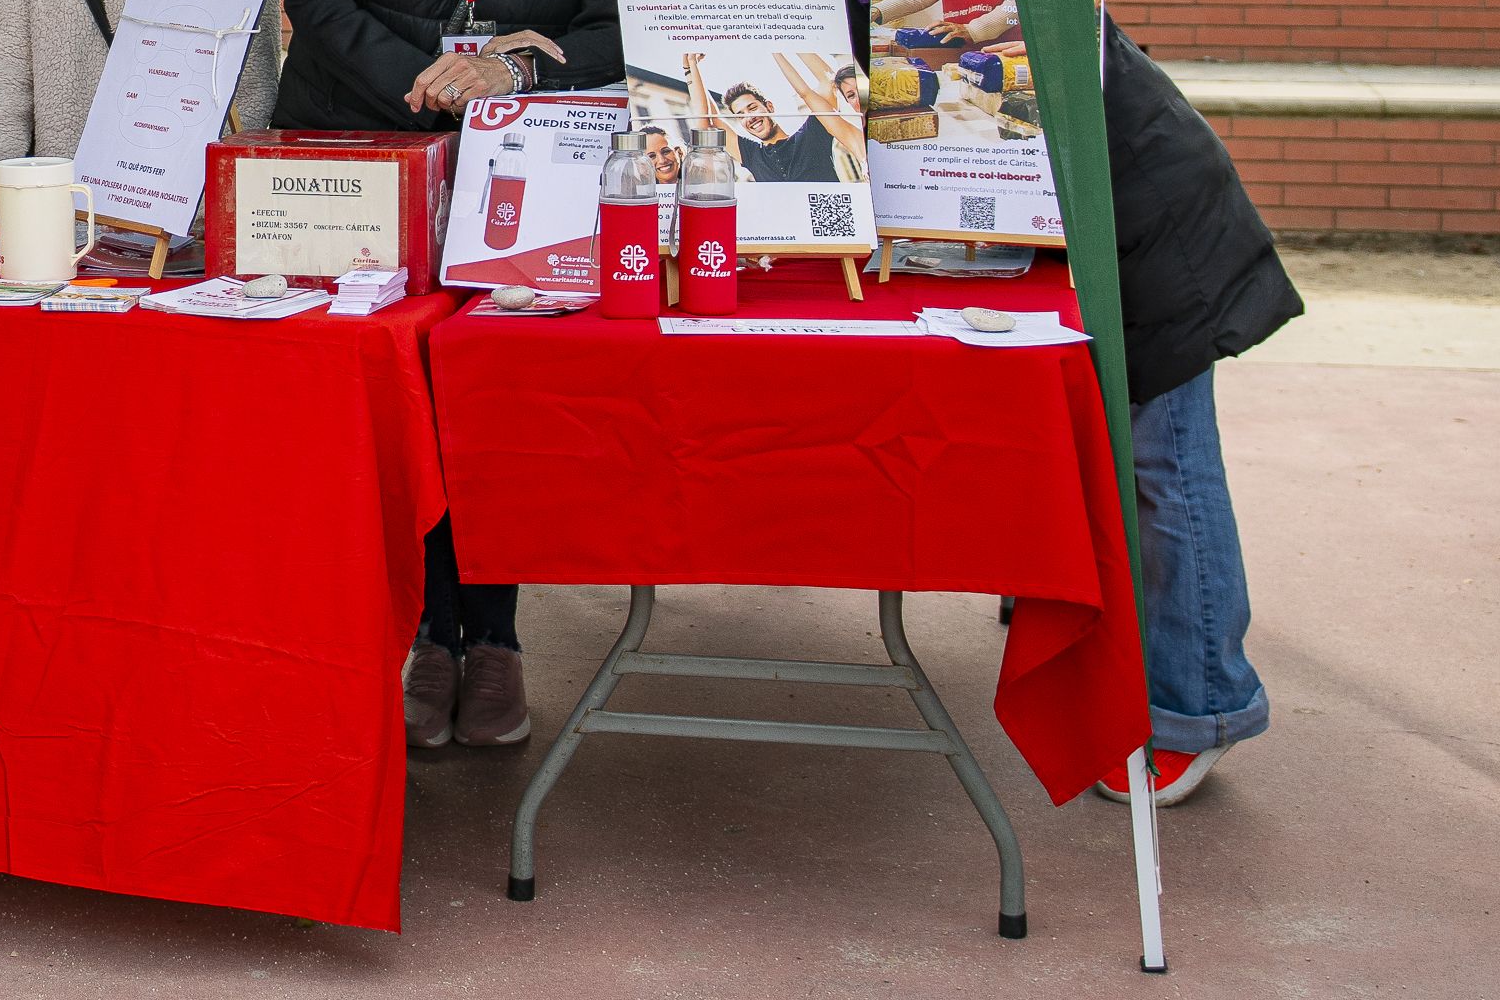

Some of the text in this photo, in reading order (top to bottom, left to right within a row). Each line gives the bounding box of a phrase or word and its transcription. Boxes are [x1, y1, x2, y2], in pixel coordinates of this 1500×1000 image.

[741, 3, 766, 11] procés
[805, 3, 835, 11] dinàmic
[567, 110, 617, 121] NO TE'N
[524, 119, 616, 132] QUEDIS SENSE!
[886, 143, 921, 151] Busquem
[940, 145, 974, 153] persones
[573, 152, 586, 160] 6€
[972, 158, 997, 166] rebost
[1010, 160, 1038, 168] Càritas.
[120, 161, 128, 170] TU,
[128, 162, 140, 172] QUÈ
[140, 165, 153, 174] POTS
[153, 168, 166, 176] FER?
[920, 168, 968, 179] T'animes
[978, 171, 1042, 182] col·laborar?
[81, 175, 90, 183] FES
[90, 177, 101, 186] UNA
[101, 179, 123, 191] POLSERA
[128, 185, 136, 193] UN
[136, 186, 147, 195] COR
[147, 189, 160, 199] AMB
[160, 191, 189, 205] NOSALTRES
[272, 177, 362, 193] DONATIUS
[123, 197, 152, 210] EXPLIQUEM
[256, 209, 288, 217] EFECTIU
[256, 221, 282, 229] BIZUM:
[284, 222, 308, 230] 33567
[491, 218, 518, 226] Càritas
[613, 272, 655, 281] Càritas
[691, 267, 731, 278] Càritas
[536, 276, 594, 285] www.caritasdtr.org
